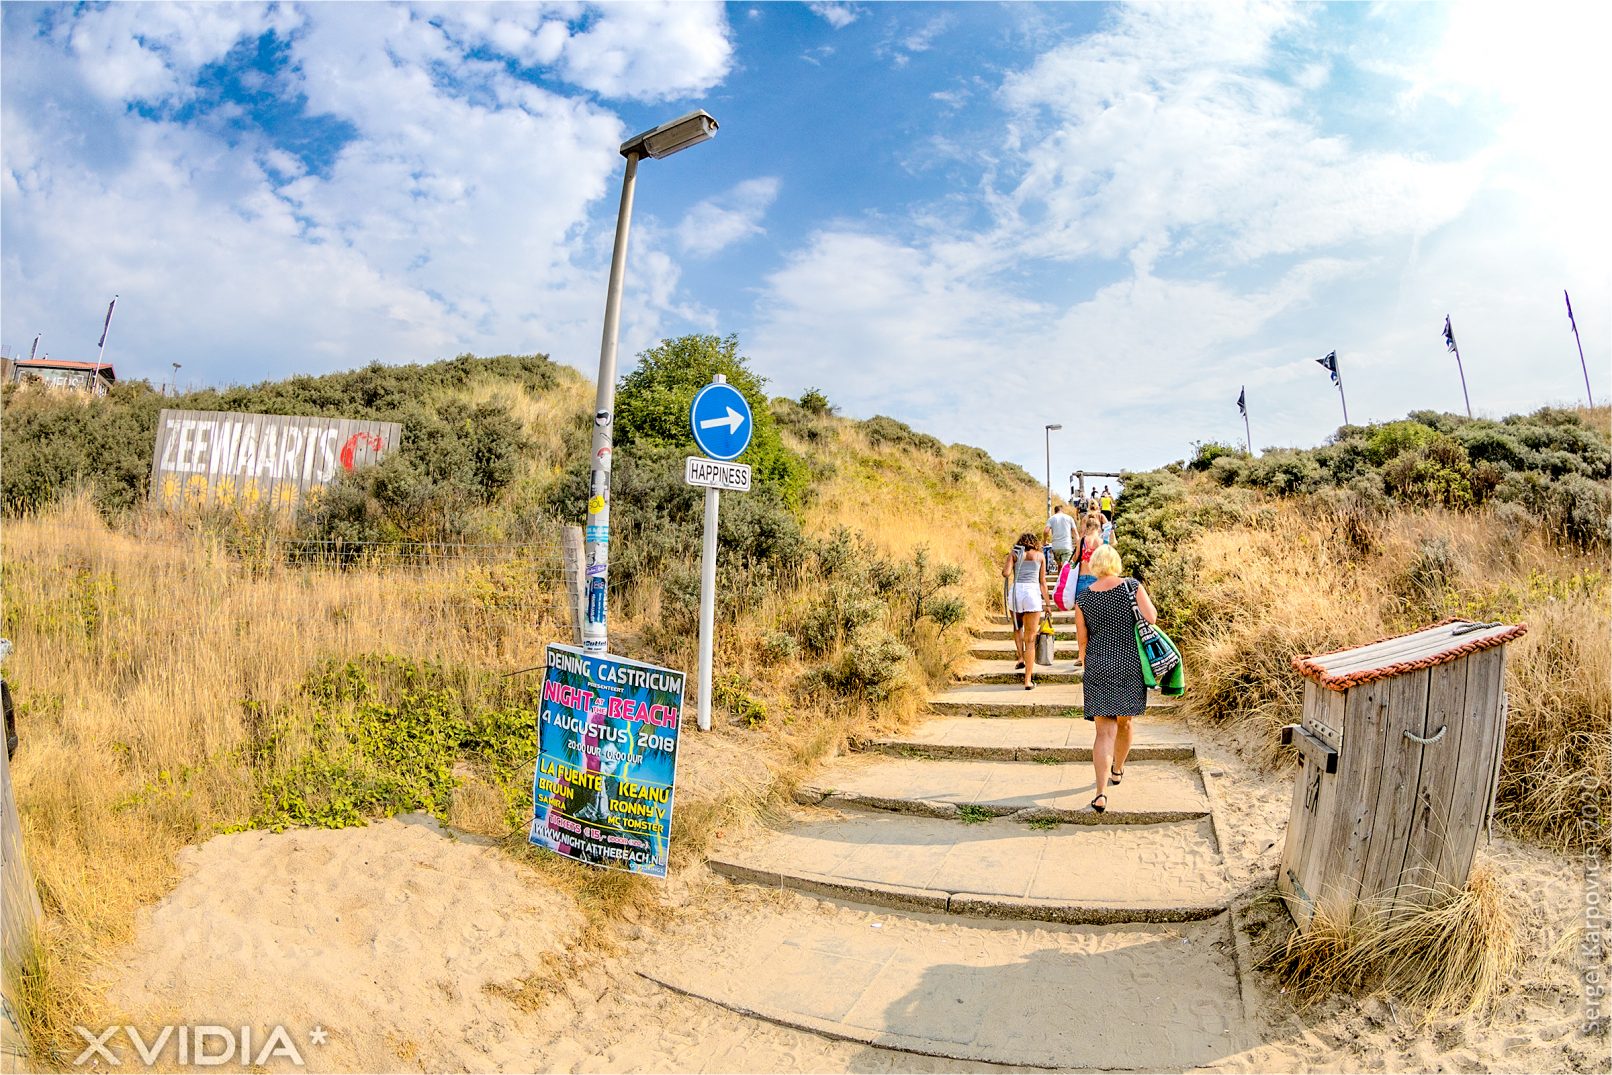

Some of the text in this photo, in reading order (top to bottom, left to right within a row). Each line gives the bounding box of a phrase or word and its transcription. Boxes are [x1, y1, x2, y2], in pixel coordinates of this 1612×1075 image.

[160, 419, 338, 482] ZEEWAARTS
[691, 463, 747, 485] HAPPINESS
[548, 651, 681, 694] DEINING CASTRICUM
[587, 681, 625, 693] PRESENTEERT
[544, 679, 678, 730] NIGHT AT THE BEACH
[542, 710, 675, 752] 4 AUGUSTUS 2018
[567, 739, 586, 752] 20:00
[586, 745, 601, 757] UUR
[627, 753, 643, 764] UUR
[540, 758, 603, 792] LA FUENTE
[538, 778, 574, 800] BRUUN
[618, 781, 670, 804] KEANU
[549, 814, 582, 834] TICKETS
[607, 815, 664, 833] MC TOMSTER
[656, 808, 666, 819] V
[534, 823, 664, 865] WWW.NIGHTATTHEBEACH.NL
